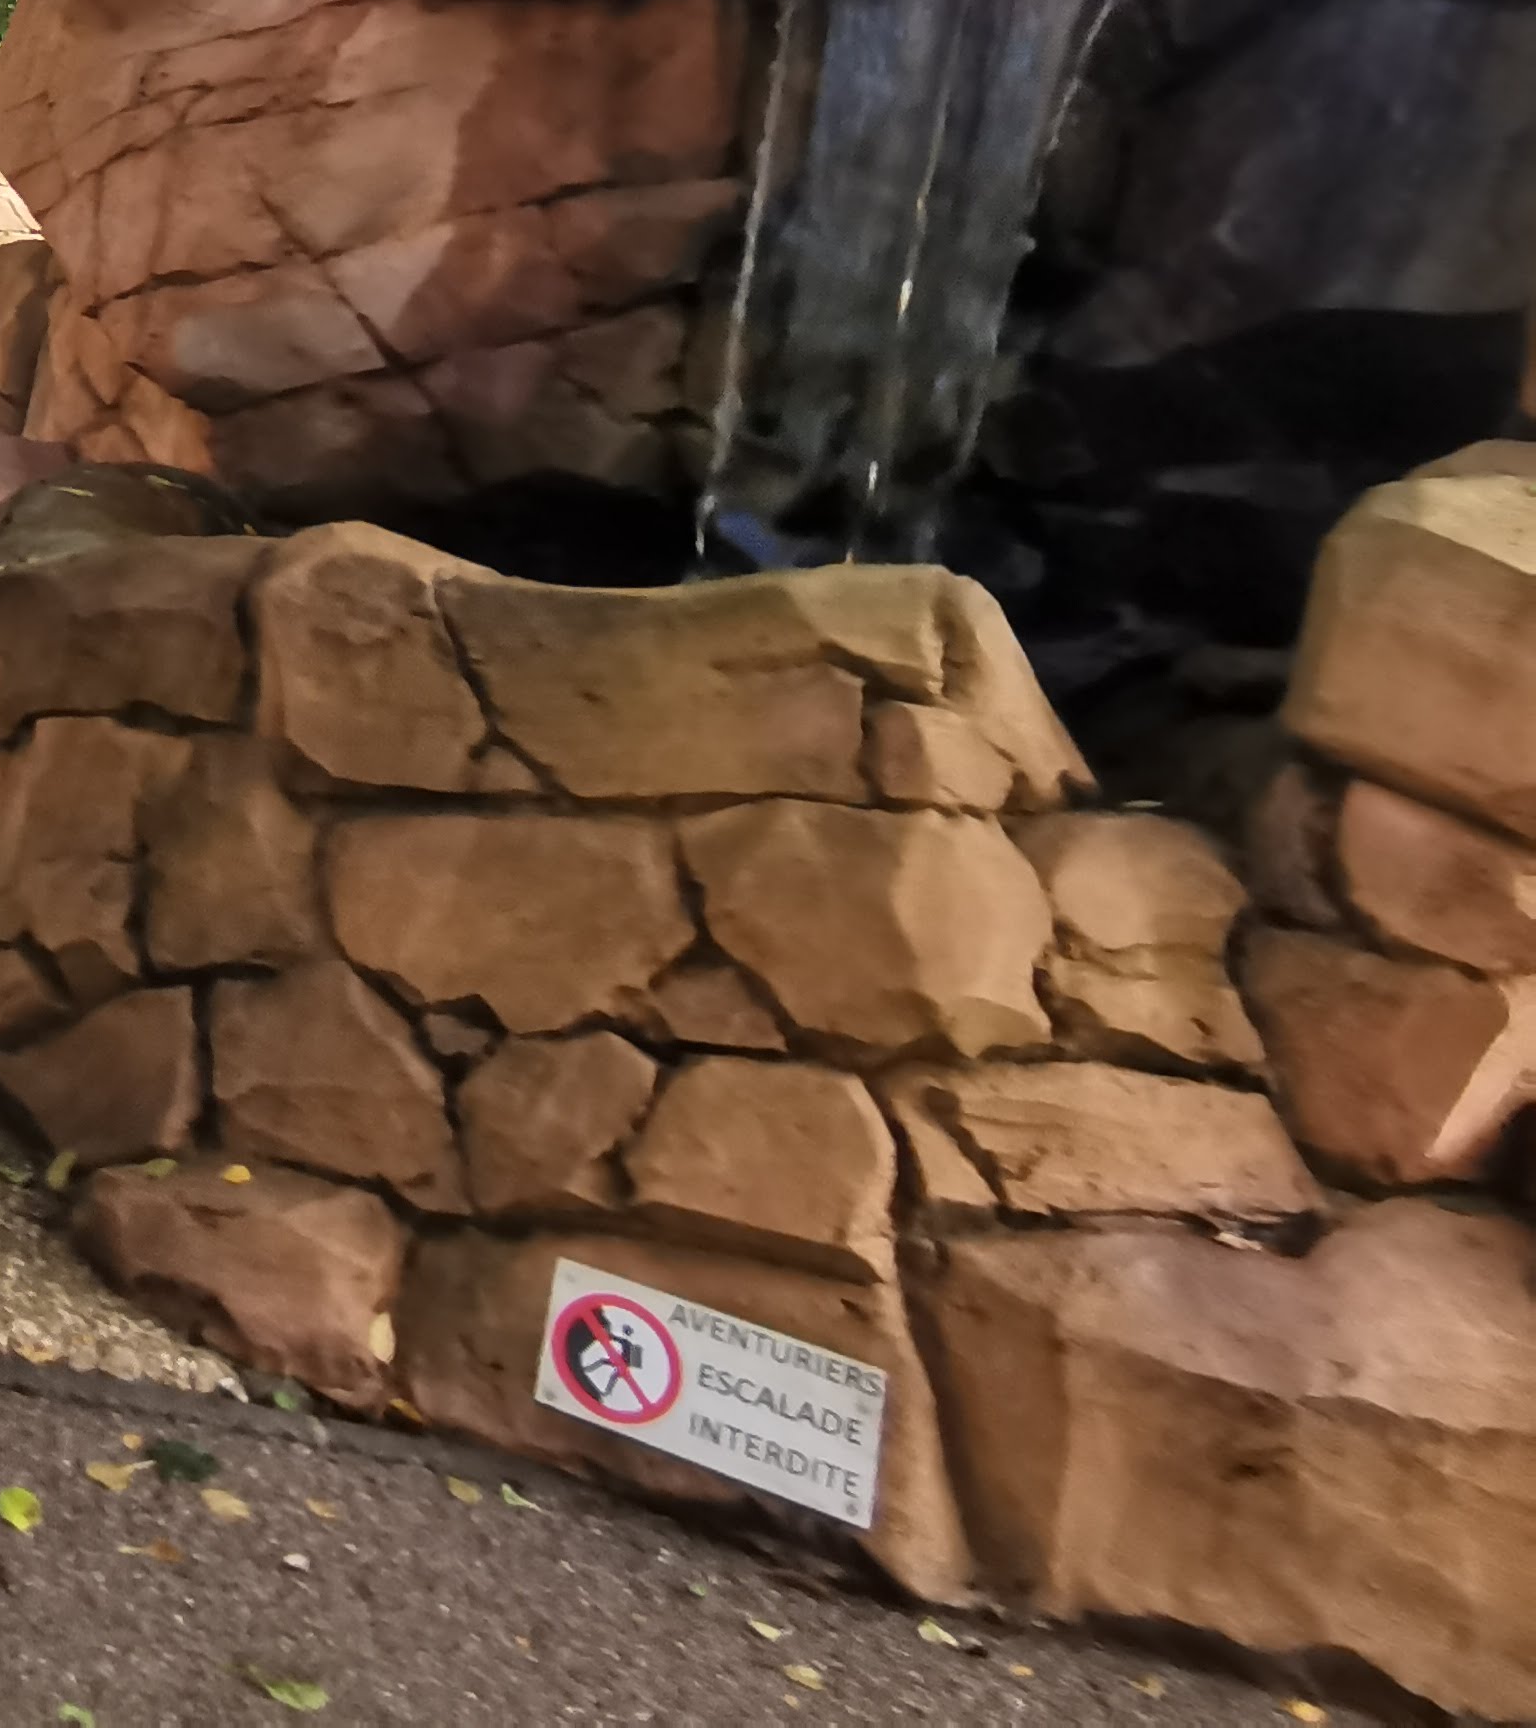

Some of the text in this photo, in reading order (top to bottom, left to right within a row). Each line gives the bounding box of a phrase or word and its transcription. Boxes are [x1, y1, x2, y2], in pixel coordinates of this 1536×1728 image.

[668, 1304, 882, 1397] AVENTURIERS
[698, 1363, 862, 1446] ESCALADE
[688, 1412, 860, 1498] INTERDITE
